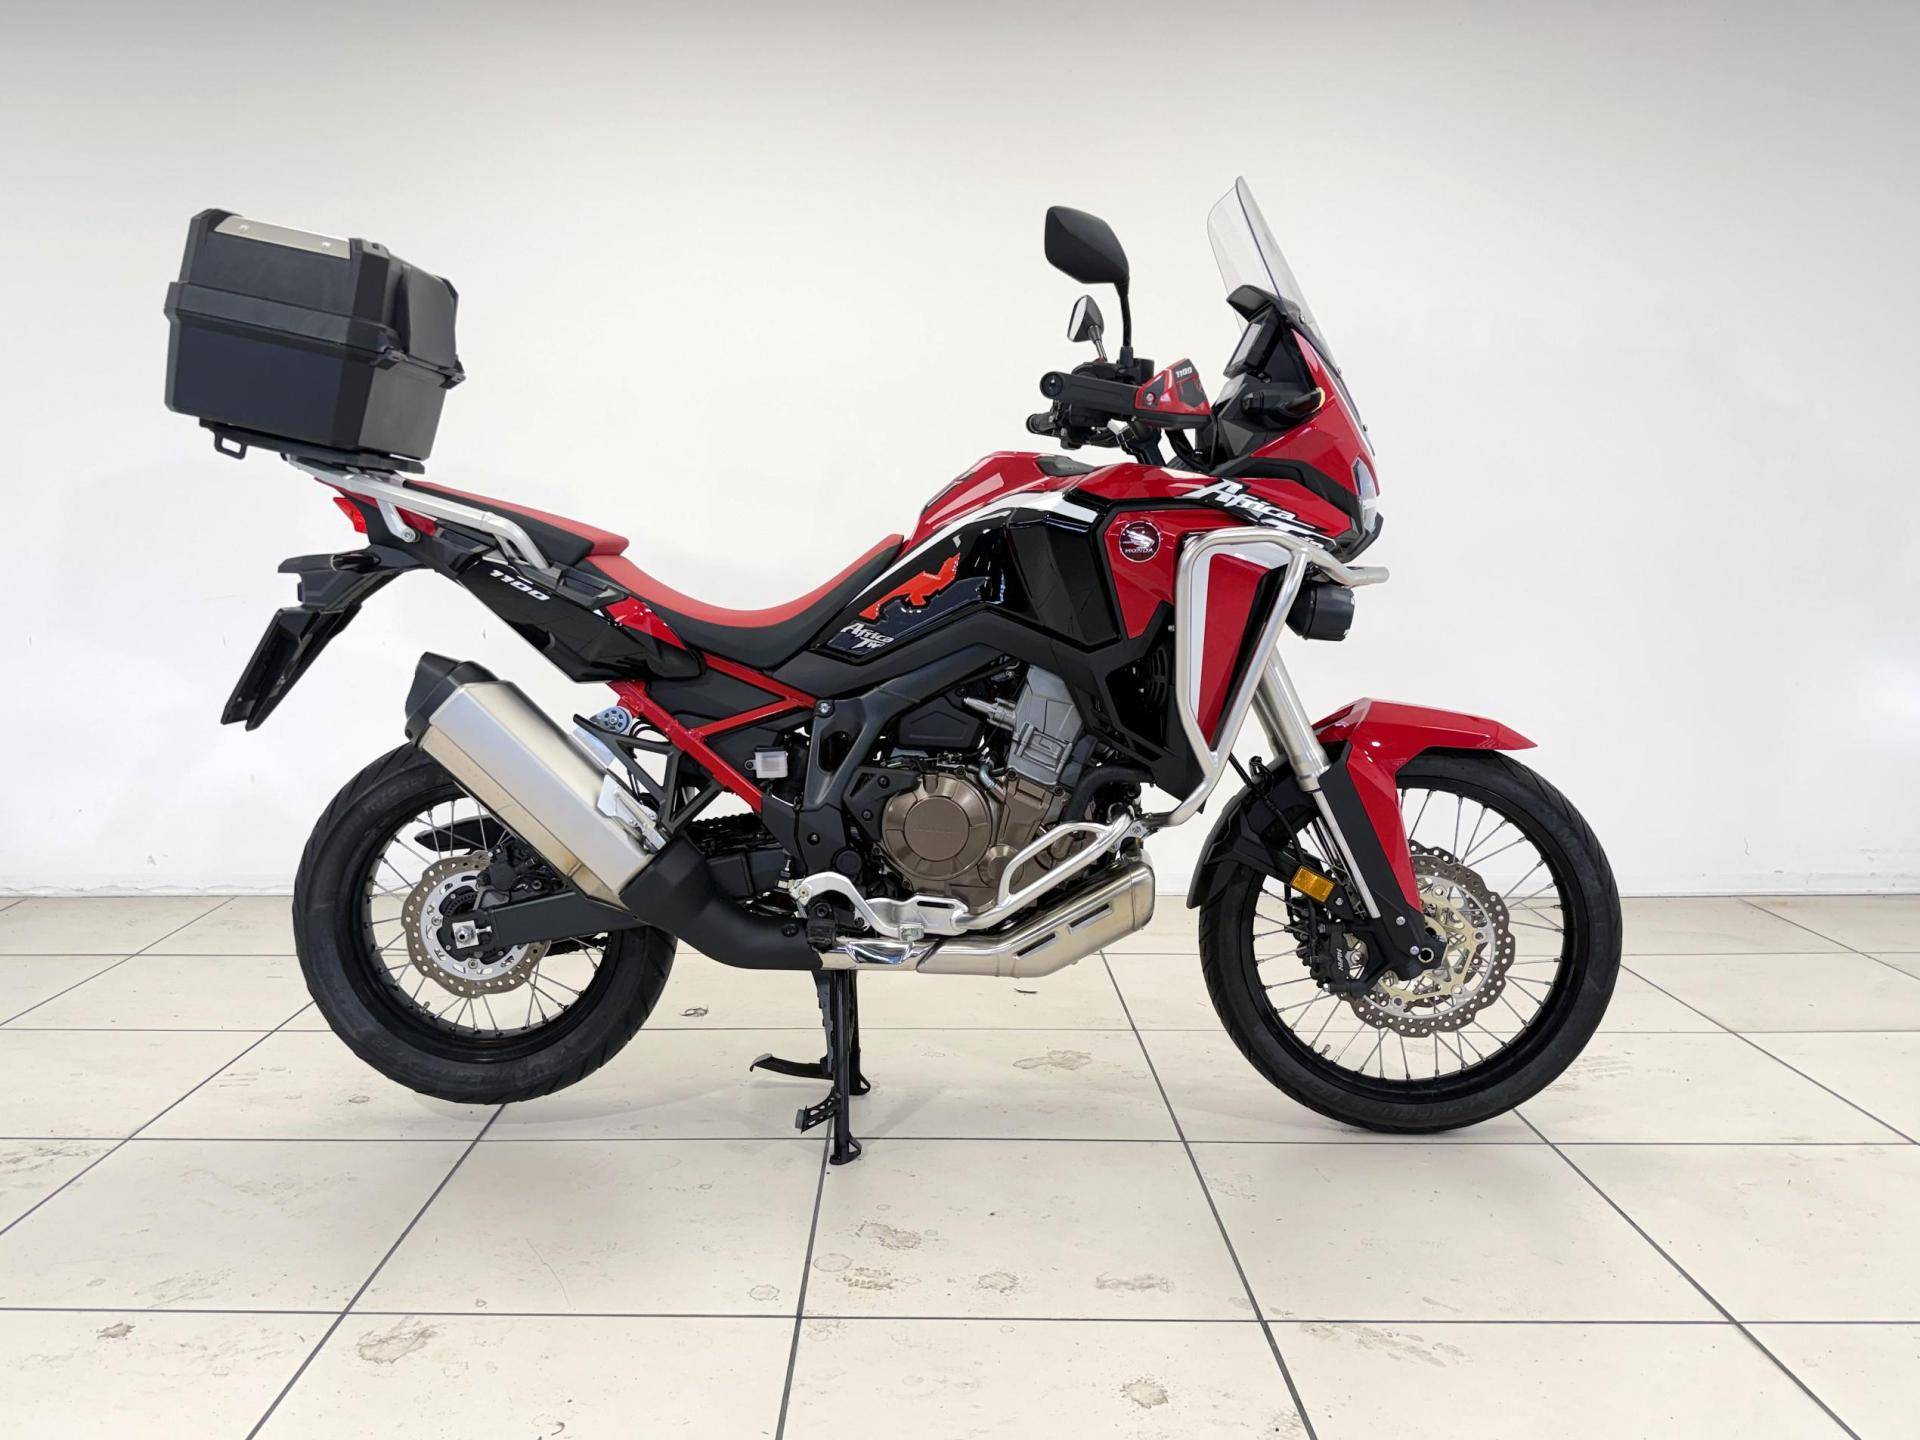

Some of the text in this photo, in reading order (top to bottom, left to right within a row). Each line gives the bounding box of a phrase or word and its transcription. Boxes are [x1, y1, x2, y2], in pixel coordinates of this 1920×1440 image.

[1175, 366, 1193, 378] 1100
[1181, 478, 1297, 521] Africa
[489, 569, 550, 601] 1100
[840, 622, 895, 643] Africa
